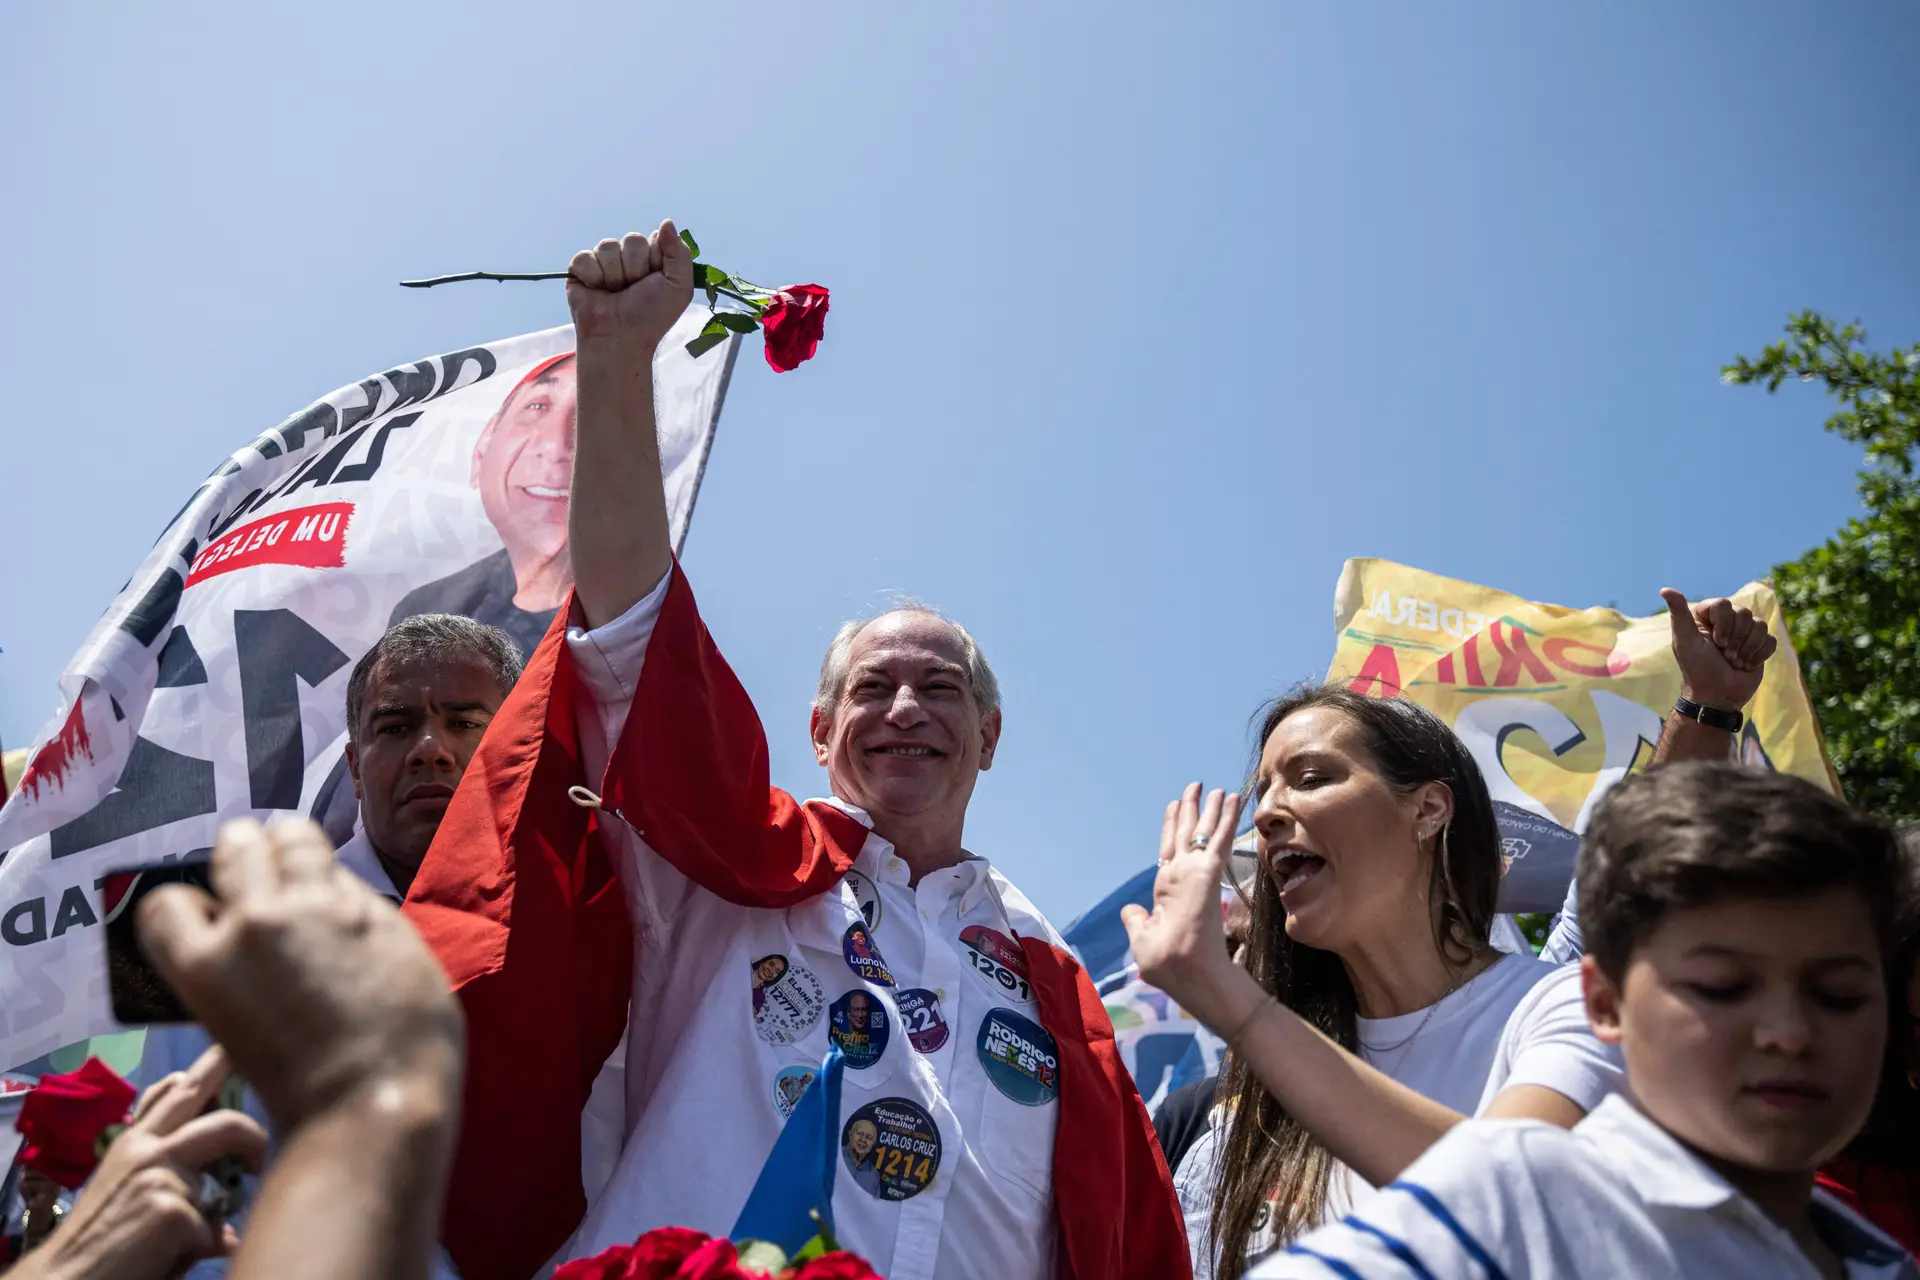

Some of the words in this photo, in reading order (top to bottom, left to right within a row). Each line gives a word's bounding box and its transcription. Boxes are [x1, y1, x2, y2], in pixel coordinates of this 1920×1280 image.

[850, 954, 880, 968] Luana
[769, 985, 801, 1018] 12777
[787, 976, 814, 1006] ELAINE
[832, 1025, 870, 1044] Prefiro
[989, 1020, 1057, 1069] RODRIGO
[874, 1107, 915, 1123] Educação
[878, 1115, 916, 1131] Trabalho!
[879, 1131, 913, 1151] CARLOS
[912, 1140, 937, 1157] CRUZ
[875, 1145, 931, 1184] 1214
